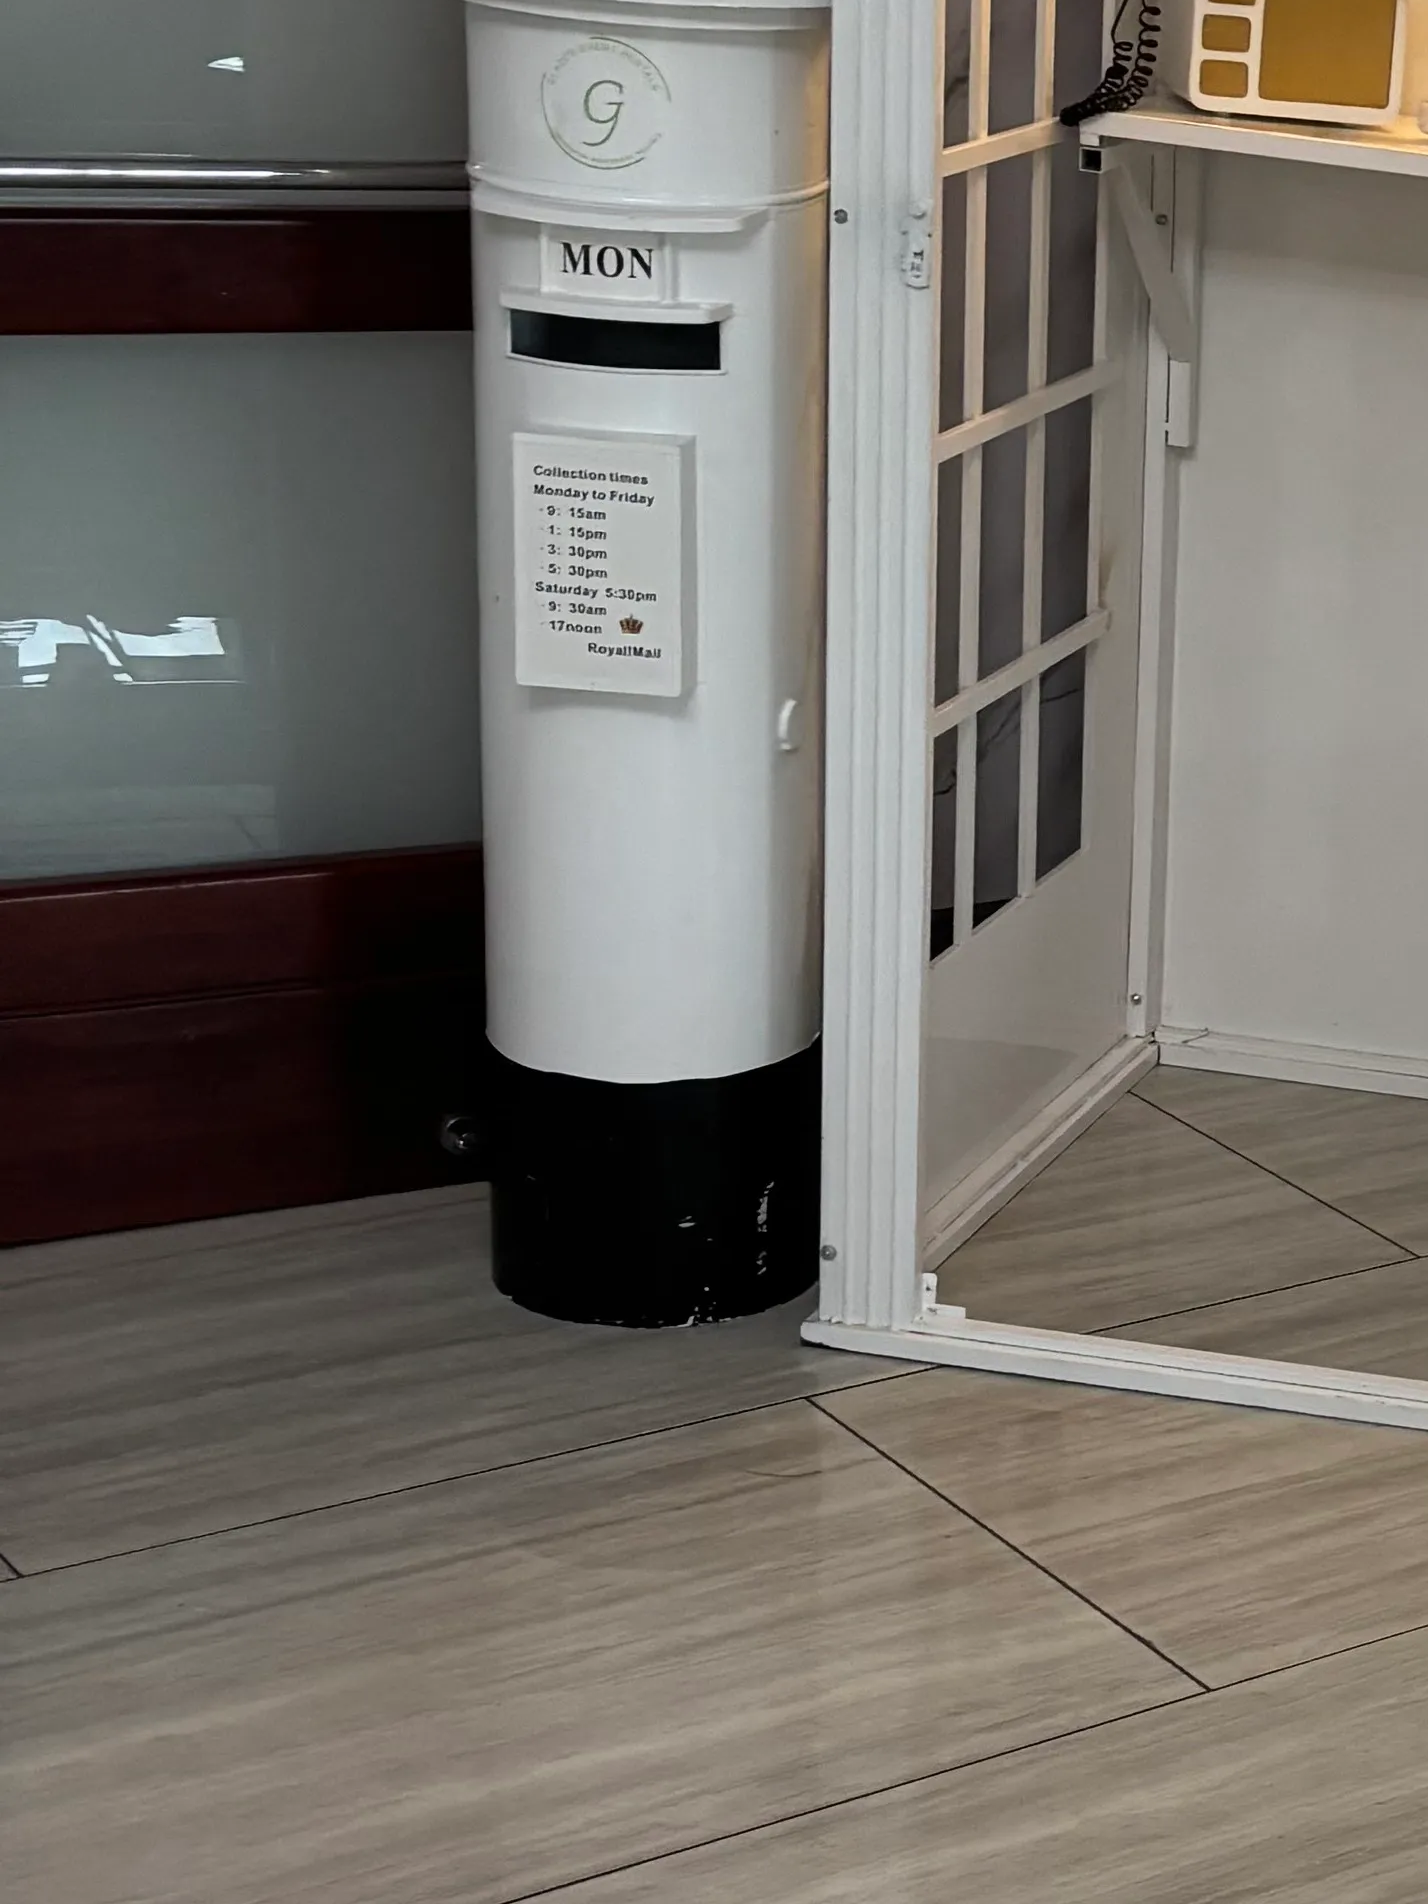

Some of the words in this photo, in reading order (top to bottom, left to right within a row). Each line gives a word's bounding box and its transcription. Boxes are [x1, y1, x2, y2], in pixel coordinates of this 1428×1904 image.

[560, 241, 654, 279] MON
[533, 465, 607, 481] Collection
[609, 472, 649, 485] times
[533, 484, 589, 501] Monday
[592, 490, 607, 500] to
[609, 490, 655, 507] Friday
[569, 507, 607, 520] 15am
[568, 546, 608, 560] 30pm
[568, 565, 608, 579] 30pm
[535, 581, 599, 598] Saturday
[605, 587, 657, 602] 5:30pm
[568, 603, 607, 616] 30am
